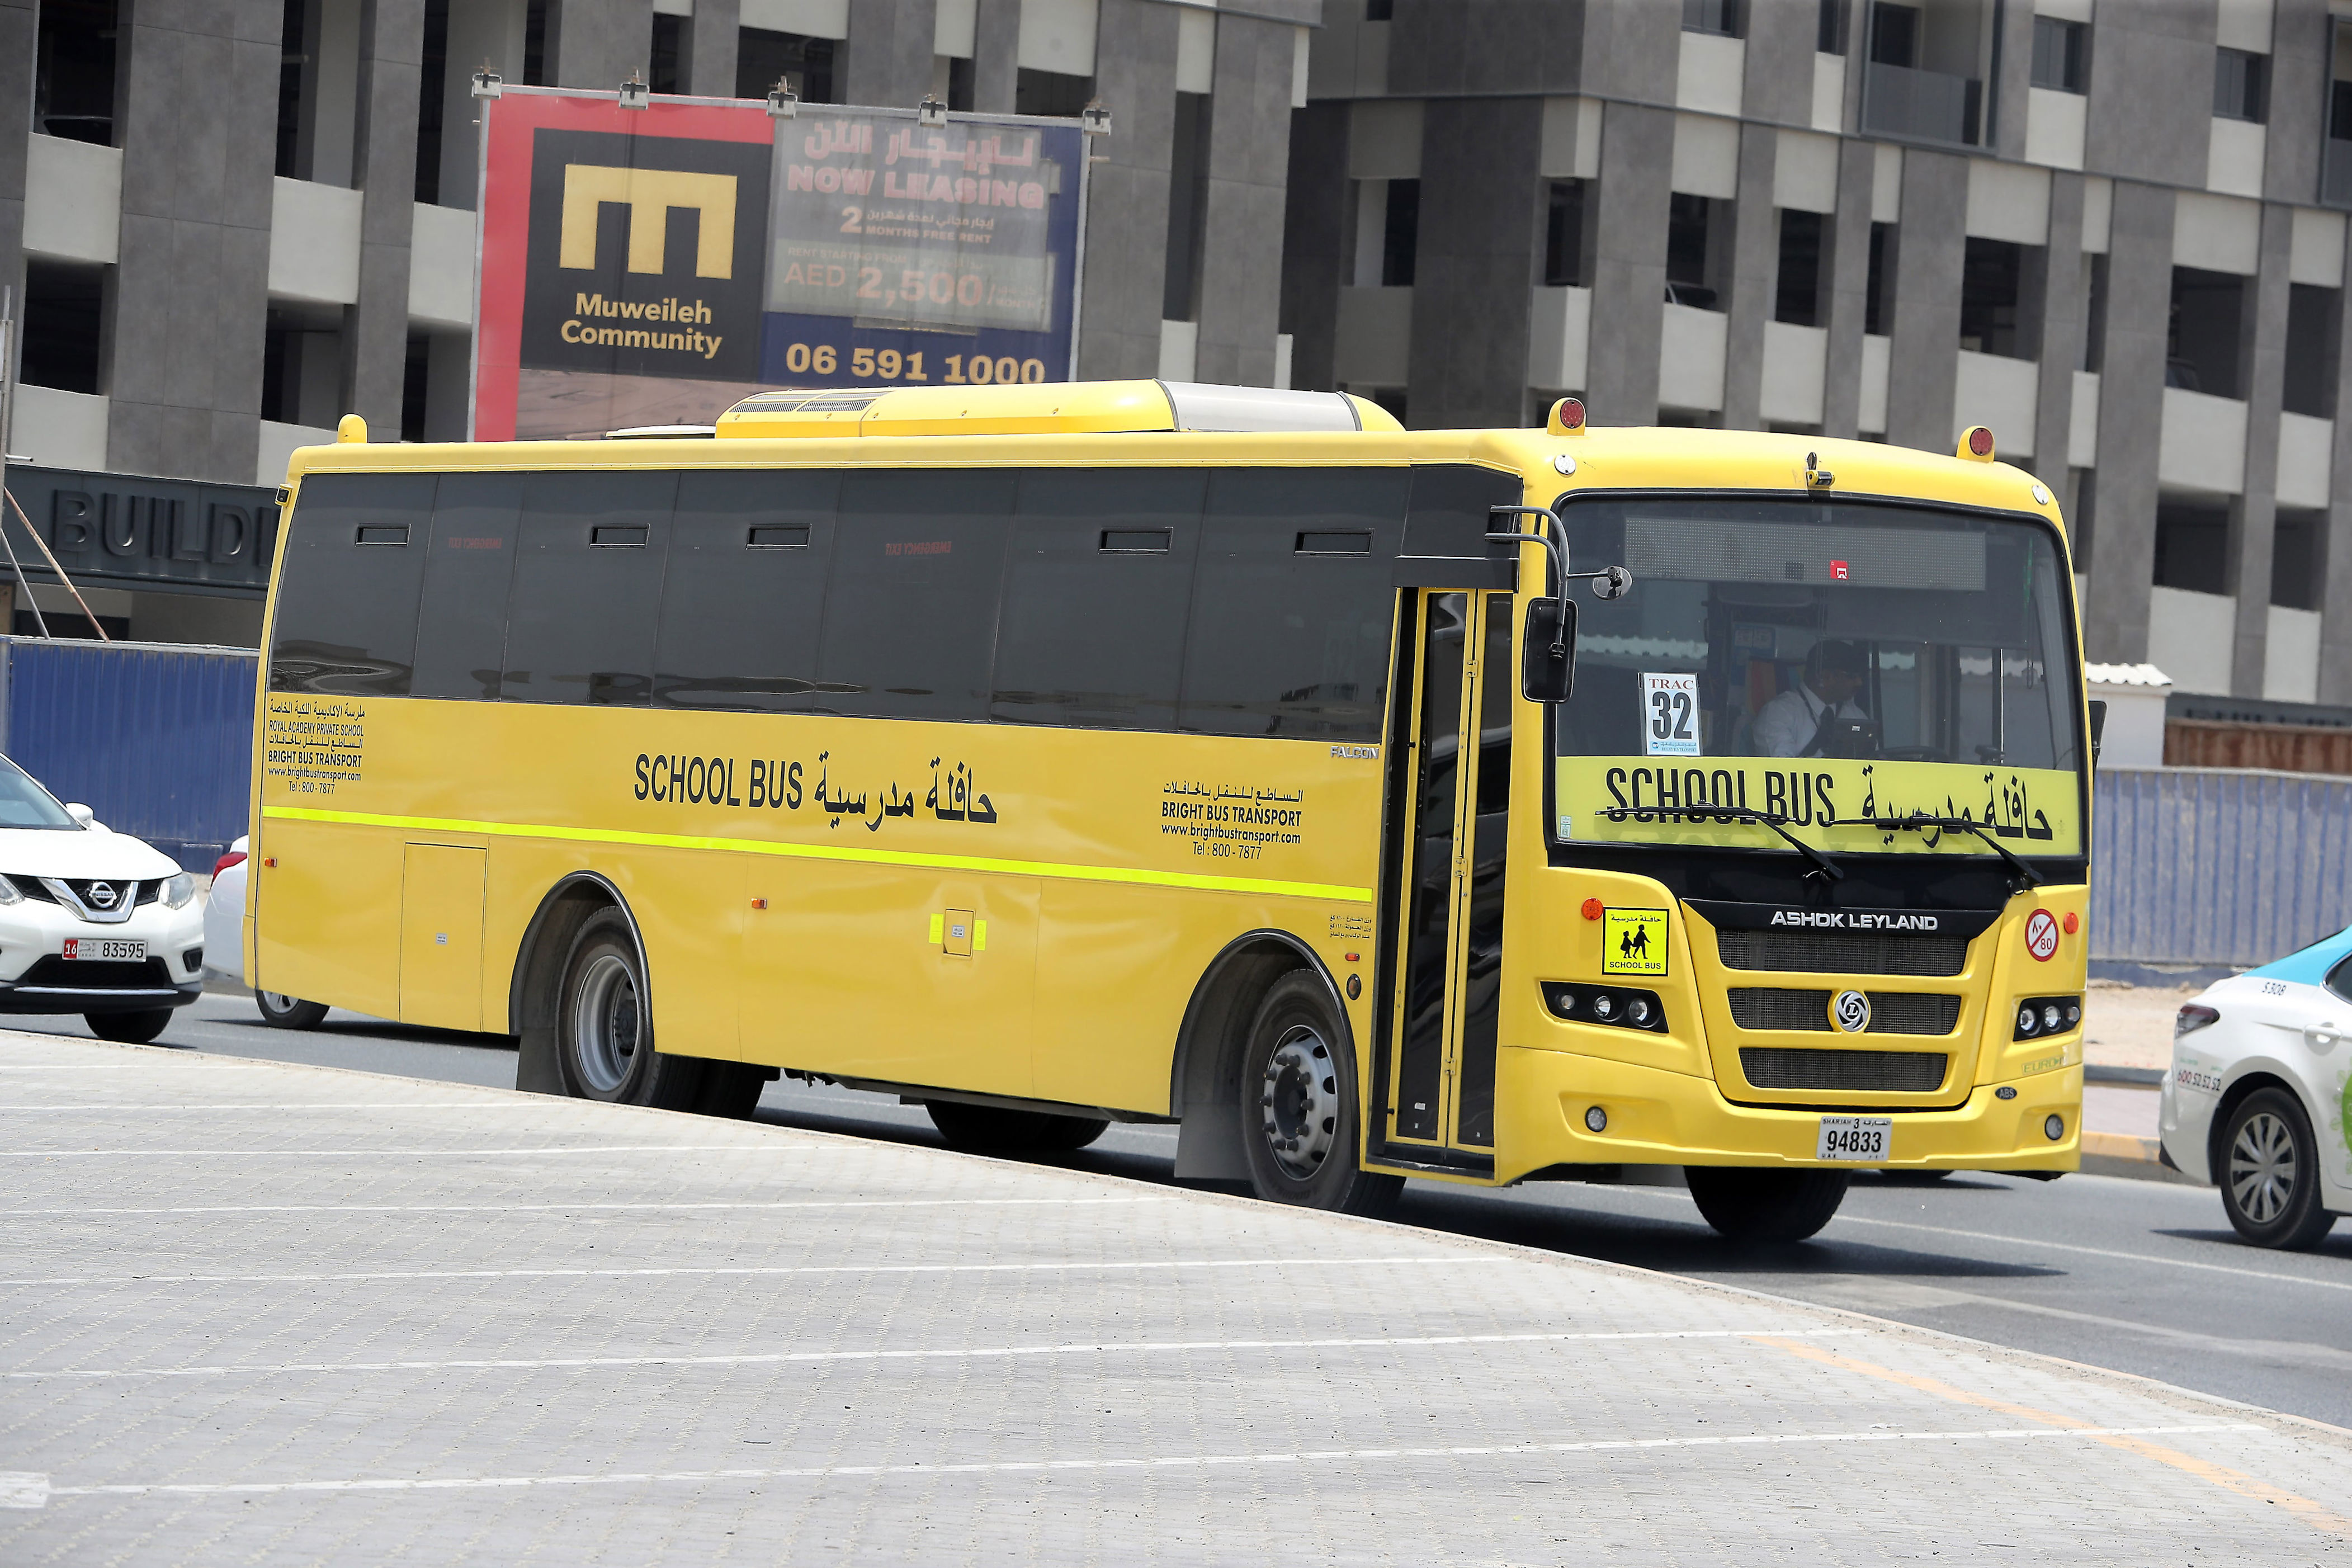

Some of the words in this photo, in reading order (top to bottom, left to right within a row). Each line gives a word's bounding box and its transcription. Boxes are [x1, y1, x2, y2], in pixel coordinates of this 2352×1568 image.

[787, 164, 876, 195] NOW
[884, 171, 1044, 209] LEASING
[840, 206, 862, 233] 2
[866, 225, 919, 238] MONTHS
[923, 229, 956, 241] FREE
[959, 233, 991, 244] RENT
[788, 247, 816, 257] RENT
[875, 253, 906, 263] FROM
[784, 262, 846, 287] AED
[856, 267, 983, 308] 2,500
[575, 292, 712, 324] Muweileh
[561, 319, 722, 360] Community
[786, 343, 837, 375] 06
[851, 347, 928, 381] 591
[944, 354, 1045, 385] 1000
[53, 489, 280, 567] BUILDI
[1649, 678, 1694, 689] TRAC
[1652, 691, 1692, 739] 32
[269, 720, 287, 733] ROYAL
[288, 722, 315, 734] ACADEMY
[317, 724, 339, 735] PRIVATE
[341, 724, 364, 736] SCHOOL
[268, 750, 296, 763] BRIGHT
[298, 752, 313, 764] BUS
[315, 753, 362, 768] TRANSPORT
[1331, 745, 1379, 759] FALCON
[268, 766, 361, 782] www.brightbustransport.com
[634, 754, 740, 807] SCHOOL
[749, 759, 803, 810] BUS
[302, 782, 314, 792] 800
[319, 783, 335, 794] 7877
[814, 750, 914, 832] مدرسية
[925, 755, 997, 823] حافلة
[1606, 767, 1756, 825] SCHOOL
[1765, 771, 1835, 828] BUS
[1162, 801, 1203, 820] BRIGHT
[1207, 805, 1229, 821] BUS
[1232, 807, 1302, 826] TRANSPORT
[1862, 764, 1975, 849] مدرسية
[1983, 771, 2053, 840] حافلة
[1161, 821, 1301, 845] www.brightbustransport.com
[1193, 842, 1205, 856] Tel
[1212, 843, 1230, 857] 800
[1238, 845, 1262, 859] 7877
[1611, 914, 1638, 923] مدرسية
[1770, 911, 1845, 928] ASHOK
[1849, 914, 1938, 931] LEYLAND
[65, 944, 77, 955] 16
[102, 942, 145, 958] 83595
[2041, 938, 2052, 950] 80
[1999, 1088, 2014, 1098] ABS
[1854, 1118, 1859, 1129] 3
[1827, 1130, 1882, 1153] 94833
